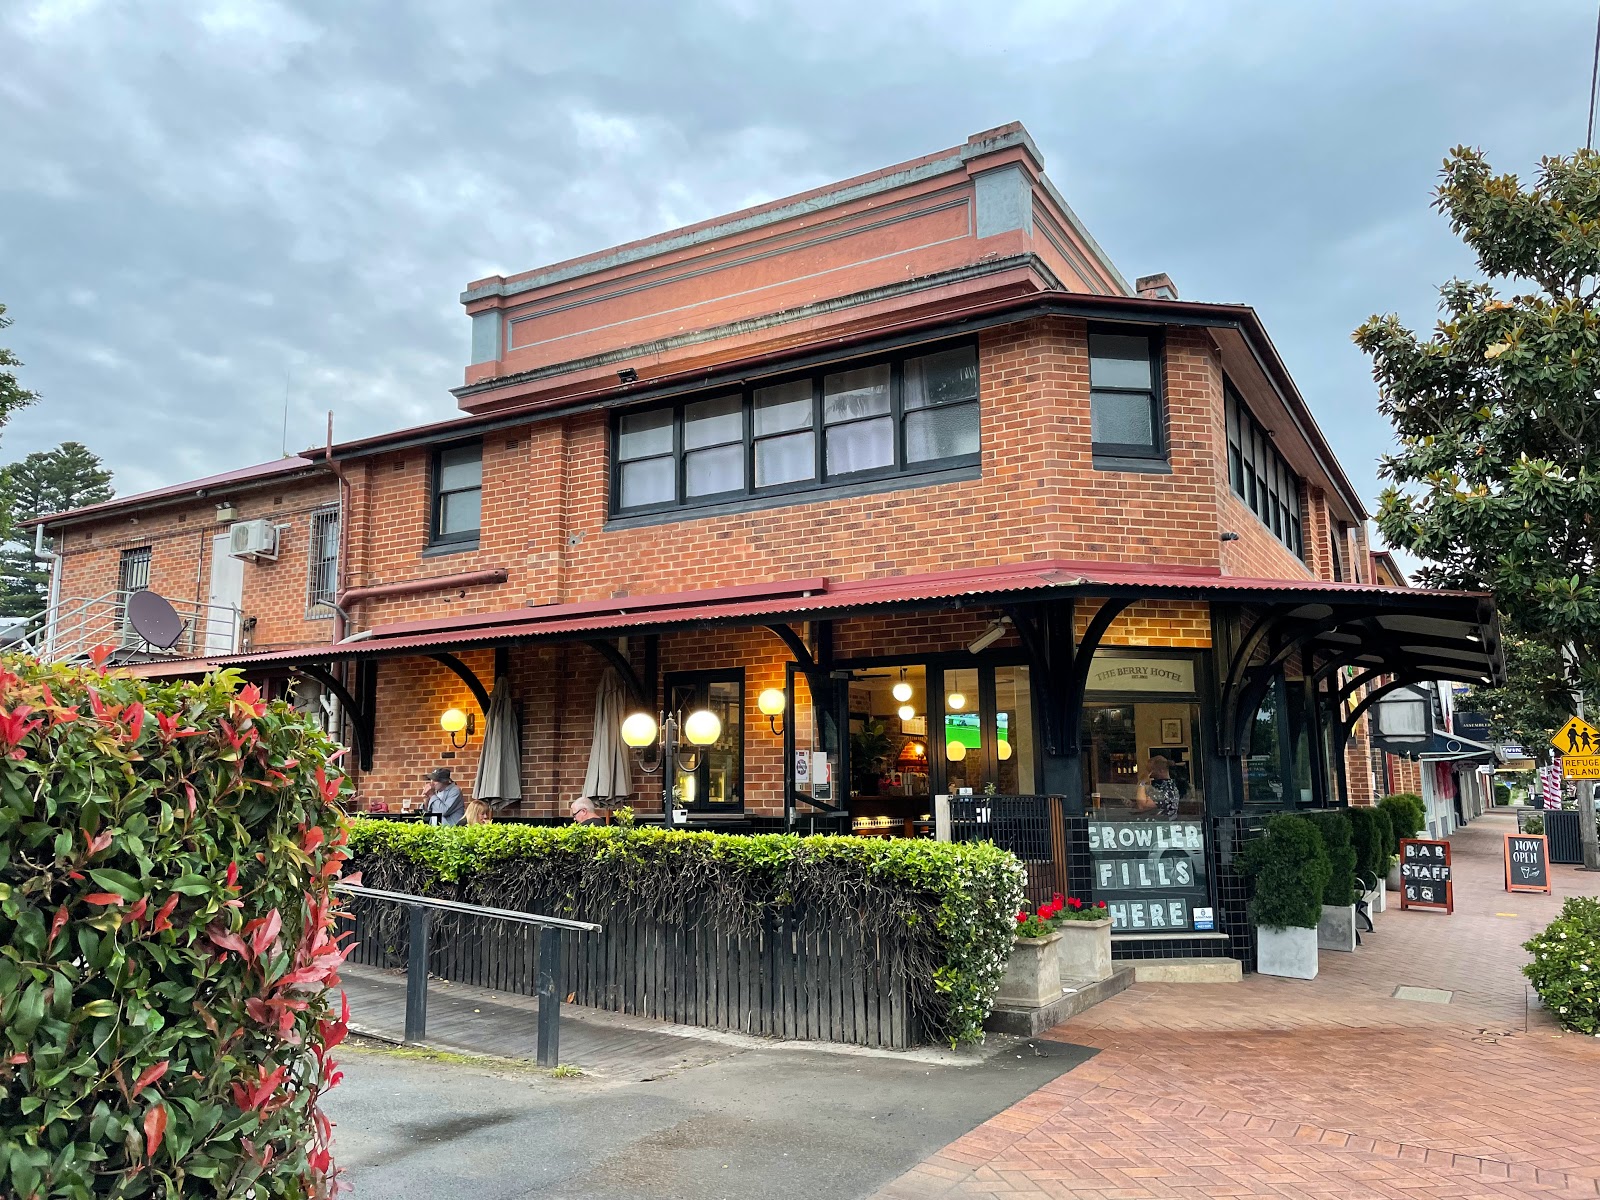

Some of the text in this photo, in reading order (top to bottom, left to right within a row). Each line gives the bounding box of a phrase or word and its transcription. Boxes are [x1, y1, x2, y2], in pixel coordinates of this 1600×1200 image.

[1095, 667, 1183, 682] THE BERRY HOTEL
[1565, 759, 1600, 767] REFUGE
[1567, 768, 1600, 776] ISLAND
[1088, 825, 1200, 849] GROWLER
[1406, 845, 1446, 858] BAR
[1515, 840, 1540, 851] NOW
[1512, 852, 1538, 864] OPEN
[1099, 861, 1190, 887] FILLS
[1402, 864, 1449, 879] STAFF
[1109, 902, 1184, 928] HERE
